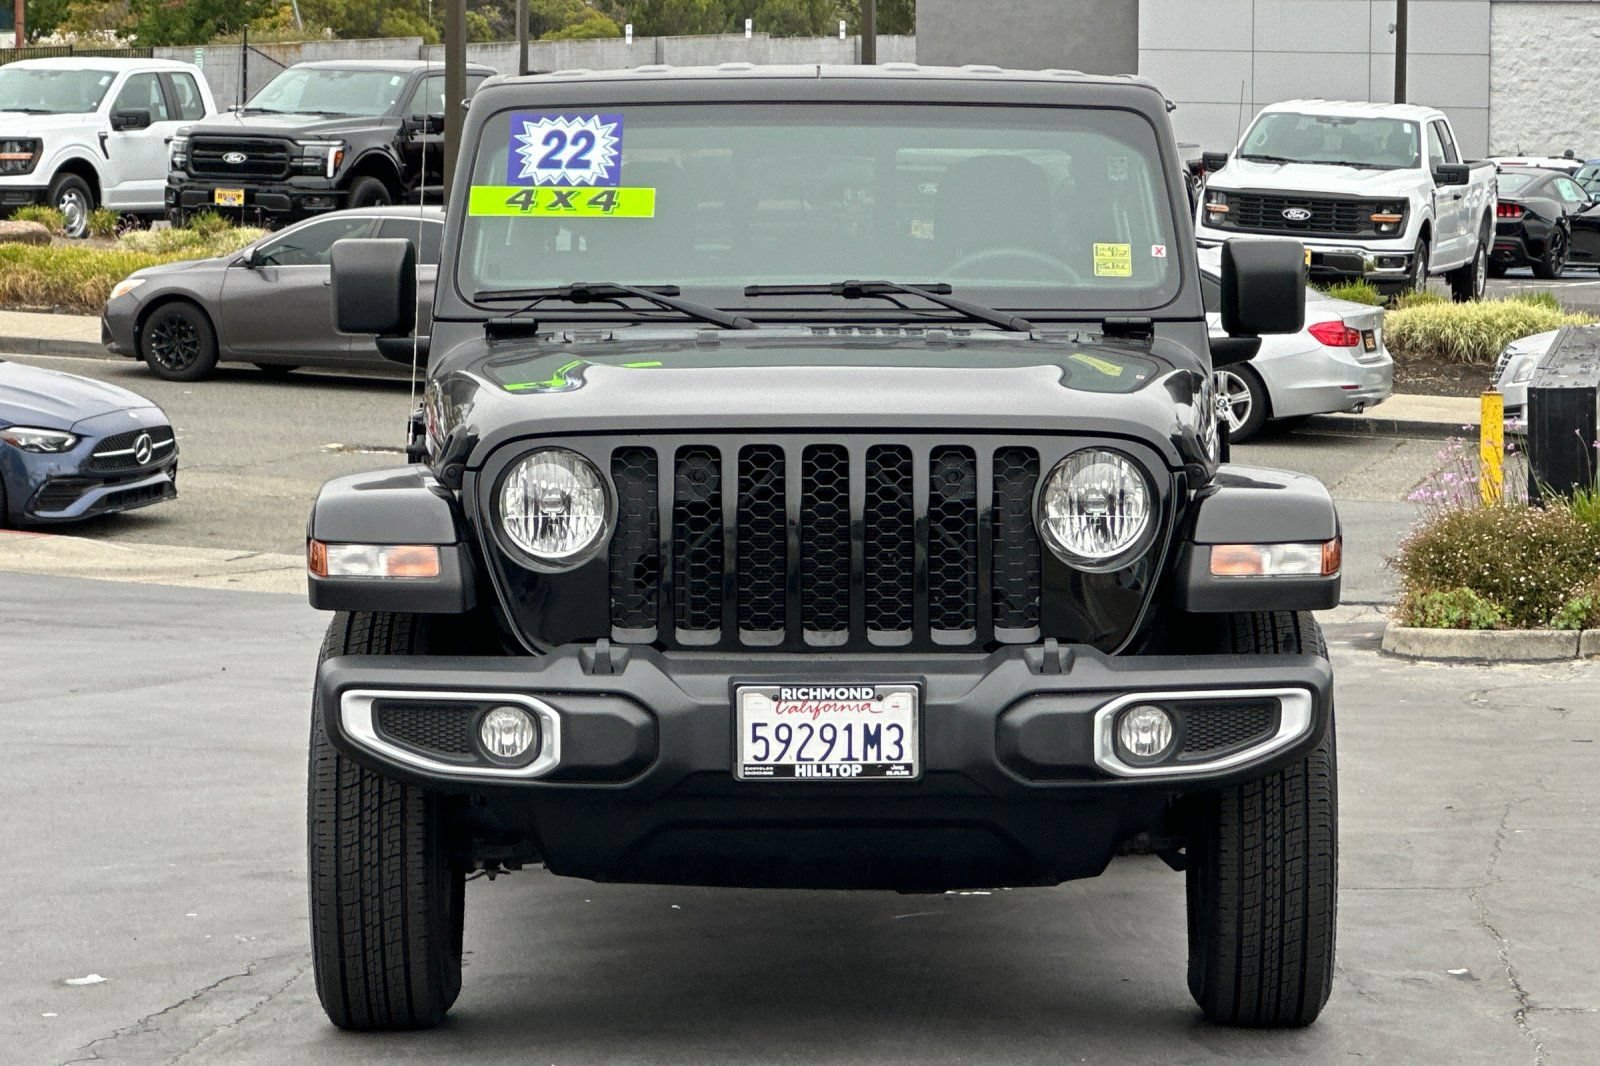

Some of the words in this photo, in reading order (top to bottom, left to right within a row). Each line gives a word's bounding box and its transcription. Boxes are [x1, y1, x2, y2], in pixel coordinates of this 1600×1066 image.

[536, 129, 596, 170] 22
[781, 688, 874, 700] RICHMOND
[775, 700, 883, 720] California
[751, 723, 904, 762] 59291M3
[795, 764, 863, 777] HILLTOP
